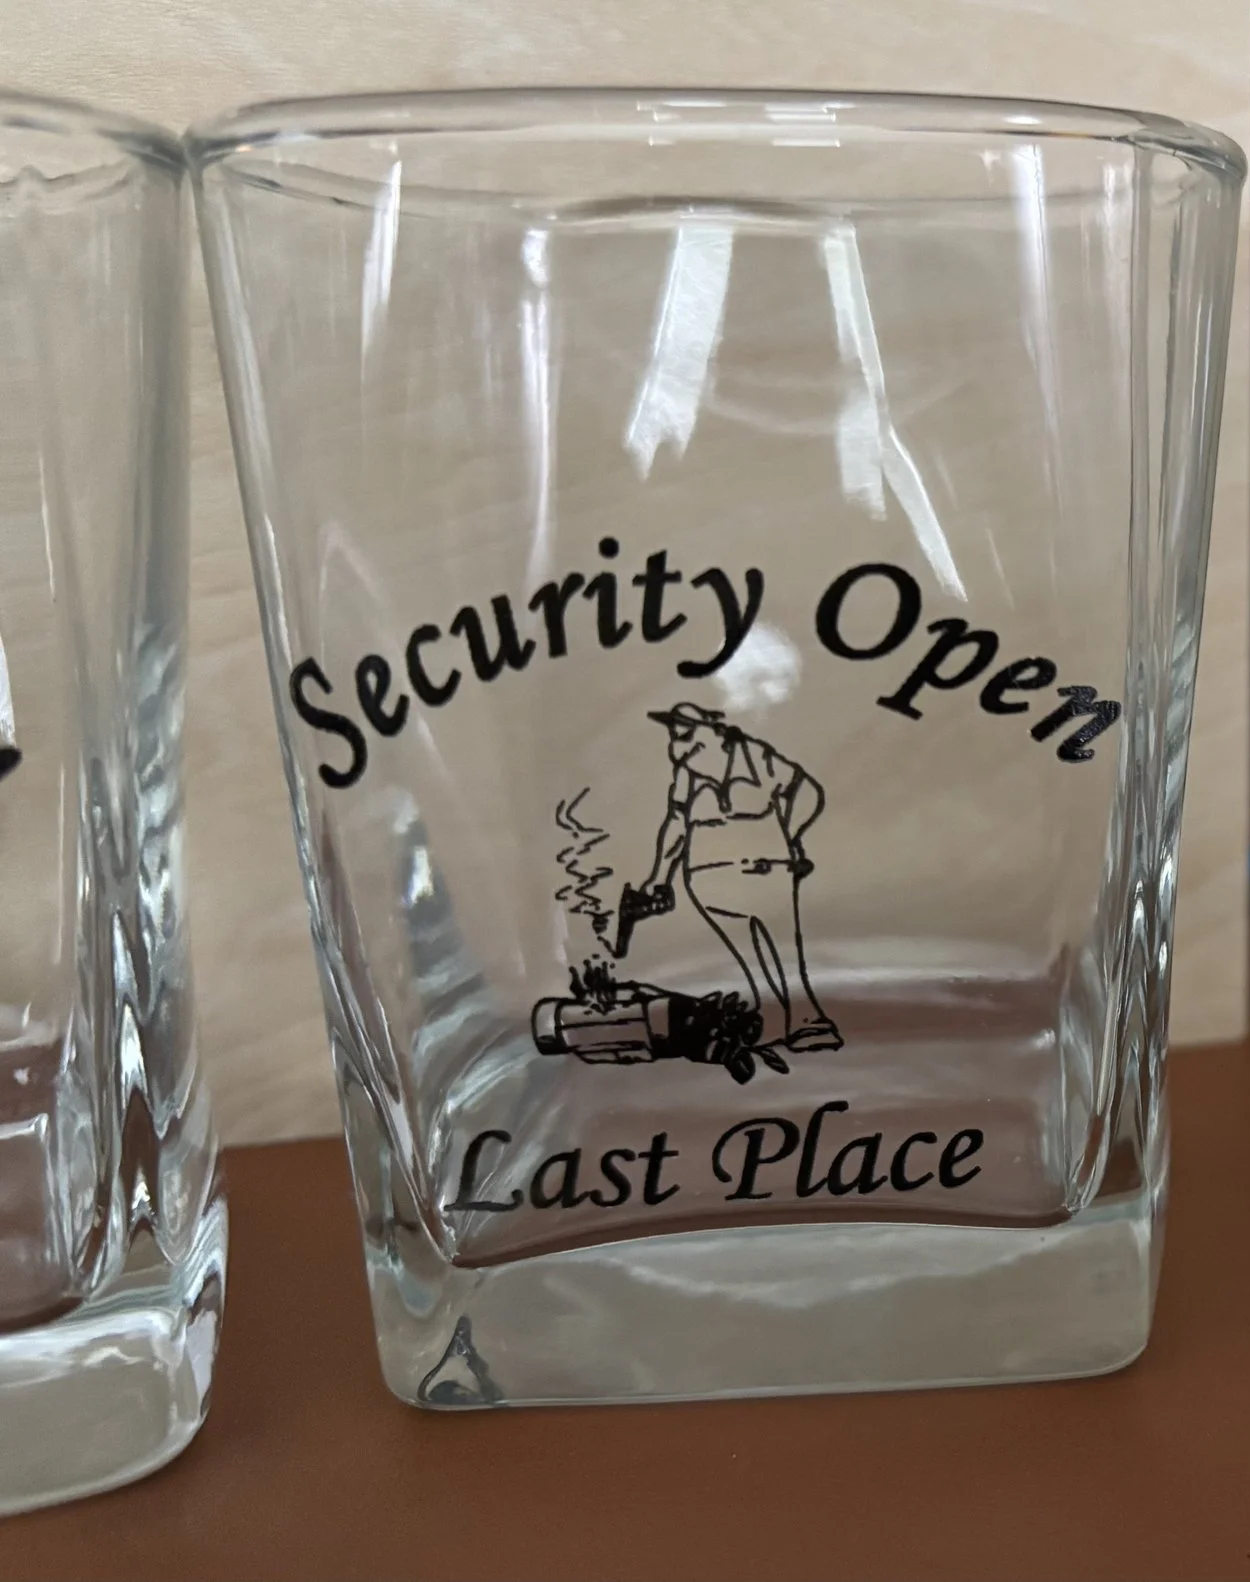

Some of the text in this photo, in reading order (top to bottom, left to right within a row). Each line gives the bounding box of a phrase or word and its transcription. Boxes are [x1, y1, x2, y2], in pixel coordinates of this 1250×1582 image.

[289, 538, 1121, 788] Security Open
[443, 1100, 984, 1212] Last Place
